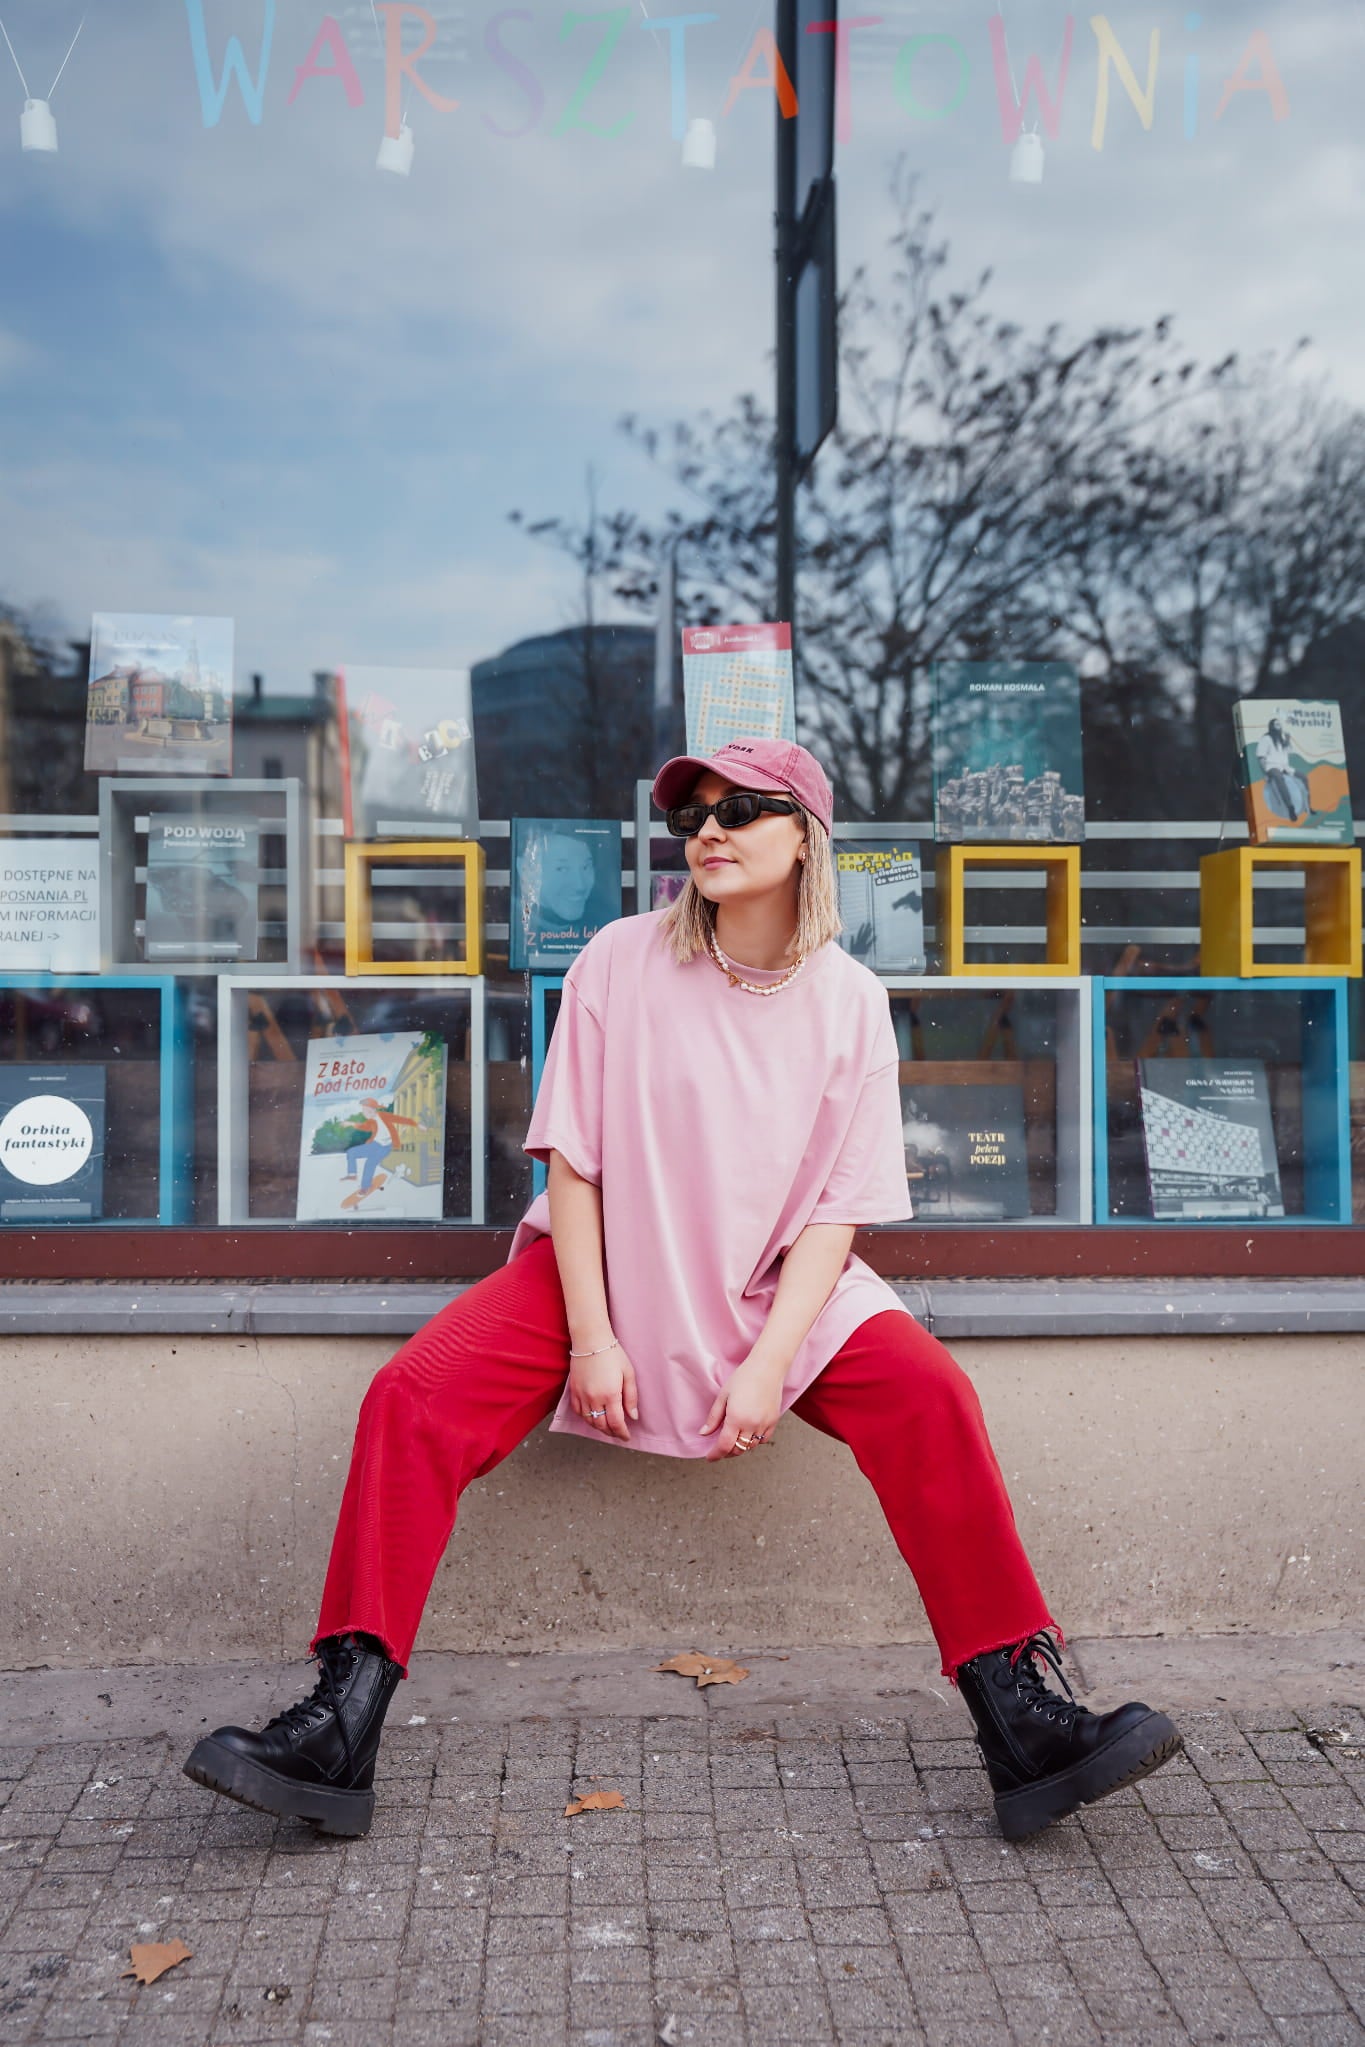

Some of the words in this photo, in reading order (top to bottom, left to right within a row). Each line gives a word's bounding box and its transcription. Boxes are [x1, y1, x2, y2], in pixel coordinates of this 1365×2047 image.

[969, 683, 1002, 692] ROMAN
[163, 826, 197, 838] POD
[4, 869, 74, 884] DOSTĘPNE
[78, 869, 97, 881] NA
[15, 910, 97, 921] INFORMACJI
[540, 926, 580, 942] powodu
[317, 1062, 328, 1078] Z
[331, 1059, 366, 1076] Bato
[314, 1078, 342, 1097] pod
[20, 1124, 71, 1136] Orbita
[967, 1132, 1006, 1143] TEATR
[4, 1137, 86, 1151] fantastyki
[970, 1155, 1006, 1166] POEZJI
